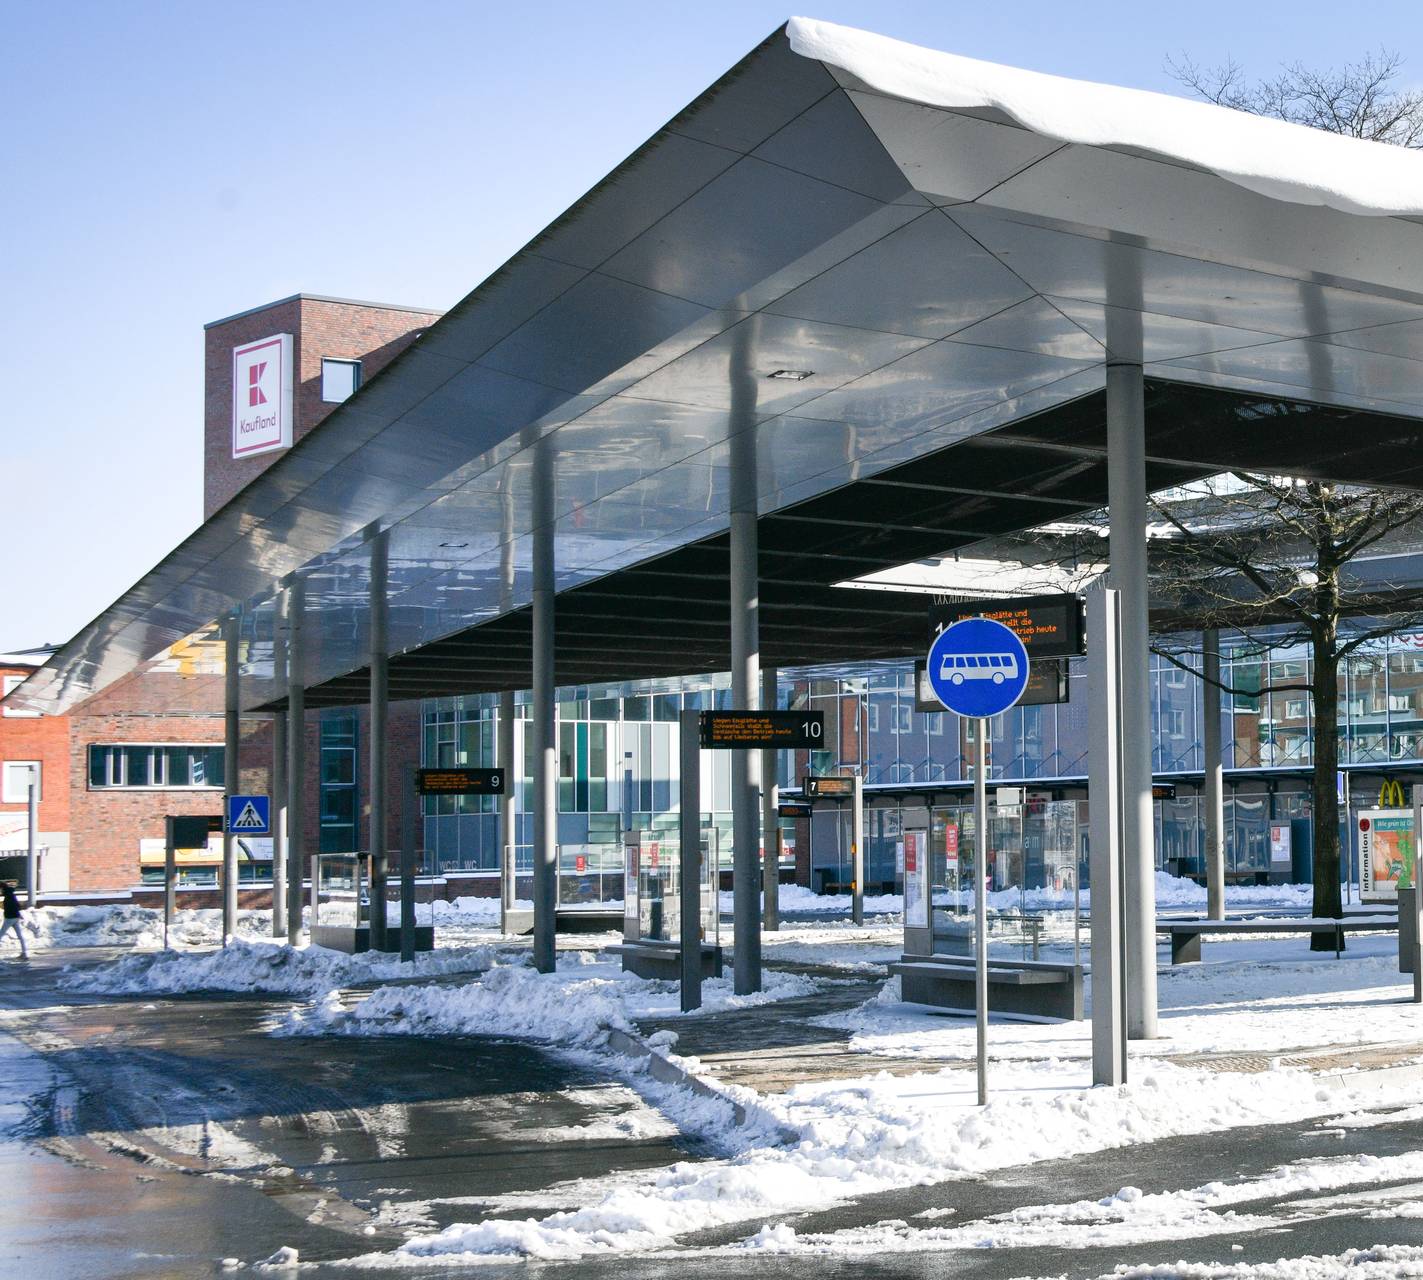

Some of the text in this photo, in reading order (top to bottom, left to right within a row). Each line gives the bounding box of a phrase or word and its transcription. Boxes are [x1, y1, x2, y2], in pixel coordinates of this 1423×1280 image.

[240, 412, 276, 433] Kaufland
[1036, 624, 1057, 633] heute
[801, 721, 821, 738] 10
[491, 775, 500, 788] 9
[811, 781, 817, 791] 7
[464, 859, 477, 870] WC
